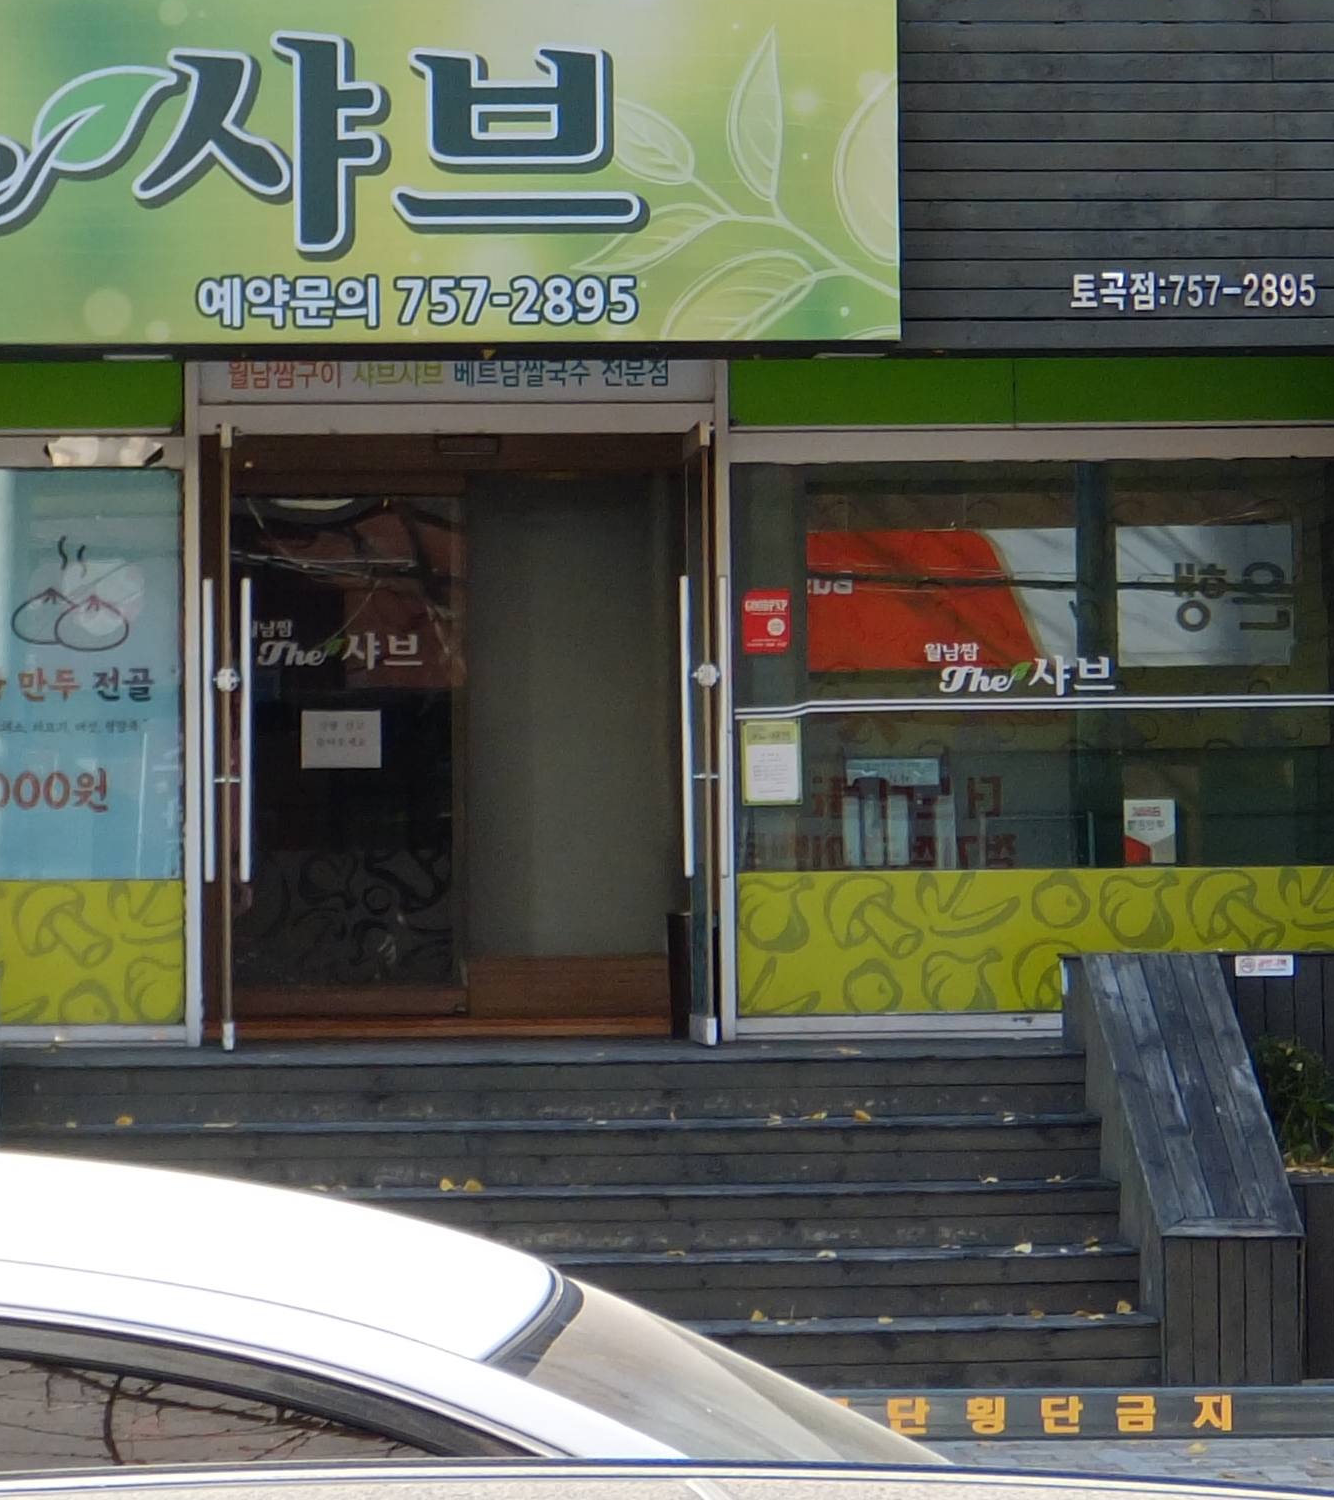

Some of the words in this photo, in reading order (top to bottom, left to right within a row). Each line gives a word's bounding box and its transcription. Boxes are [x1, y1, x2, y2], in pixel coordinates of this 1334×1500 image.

[131, 28, 652, 260] 샤브
[195, 273, 380, 331] 예약문의
[394, 271, 641, 330] 757-2895
[227, 360, 342, 389] 월남쌈구이
[351, 360, 445, 388] 샤브샤브
[453, 361, 592, 389] 베트남쌀국수
[601, 360, 669, 389] 전문점
[257, 639, 329, 668] The
[342, 631, 424, 671] 샤브
[17, 666, 82, 703] 만두
[92, 666, 156, 703] 전골
[938, 663, 1012, 694] The
[1027, 655, 1117, 696] 샤브
